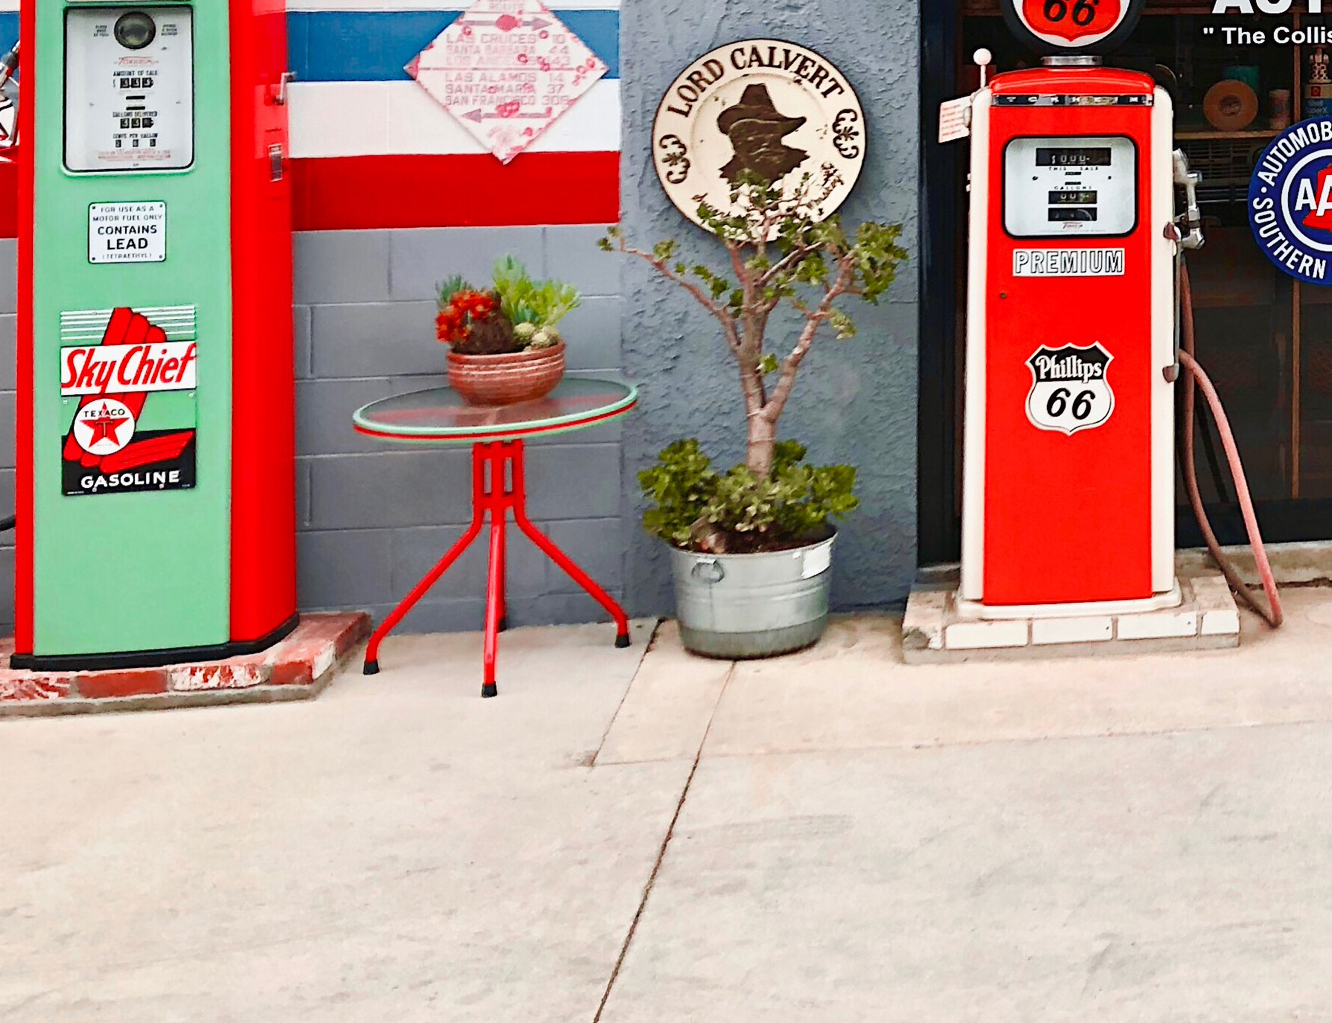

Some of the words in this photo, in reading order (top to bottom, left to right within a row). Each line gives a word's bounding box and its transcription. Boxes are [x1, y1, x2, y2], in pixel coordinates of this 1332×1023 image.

[446, 34, 476, 44] LAS
[481, 34, 536, 44] CRUCES
[553, 34, 566, 43] 10
[1222, 27, 1266, 44] The
[549, 45, 570, 54] 44
[445, 73, 473, 82] LAS
[479, 73, 536, 82] ALAMOS
[549, 73, 564, 82] 14
[667, 58, 725, 118] LORD
[730, 46, 845, 99] CALVERT
[445, 84, 486, 94] SANTA
[547, 84, 564, 94] 37
[445, 95, 469, 105] SAN
[98, 224, 158, 235] CONTAINS
[107, 237, 149, 250] LEAD
[1252, 197, 1326, 279] SOUTHERN
[1015, 250, 1124, 275] PREMIUM
[60, 348, 117, 394] Sky
[117, 342, 197, 386] Chief
[1035, 355, 1102, 384] Phillips
[1046, 387, 1096, 420] 66
[84, 408, 126, 418] TEXACO
[81, 470, 180, 489] GASOLINE
